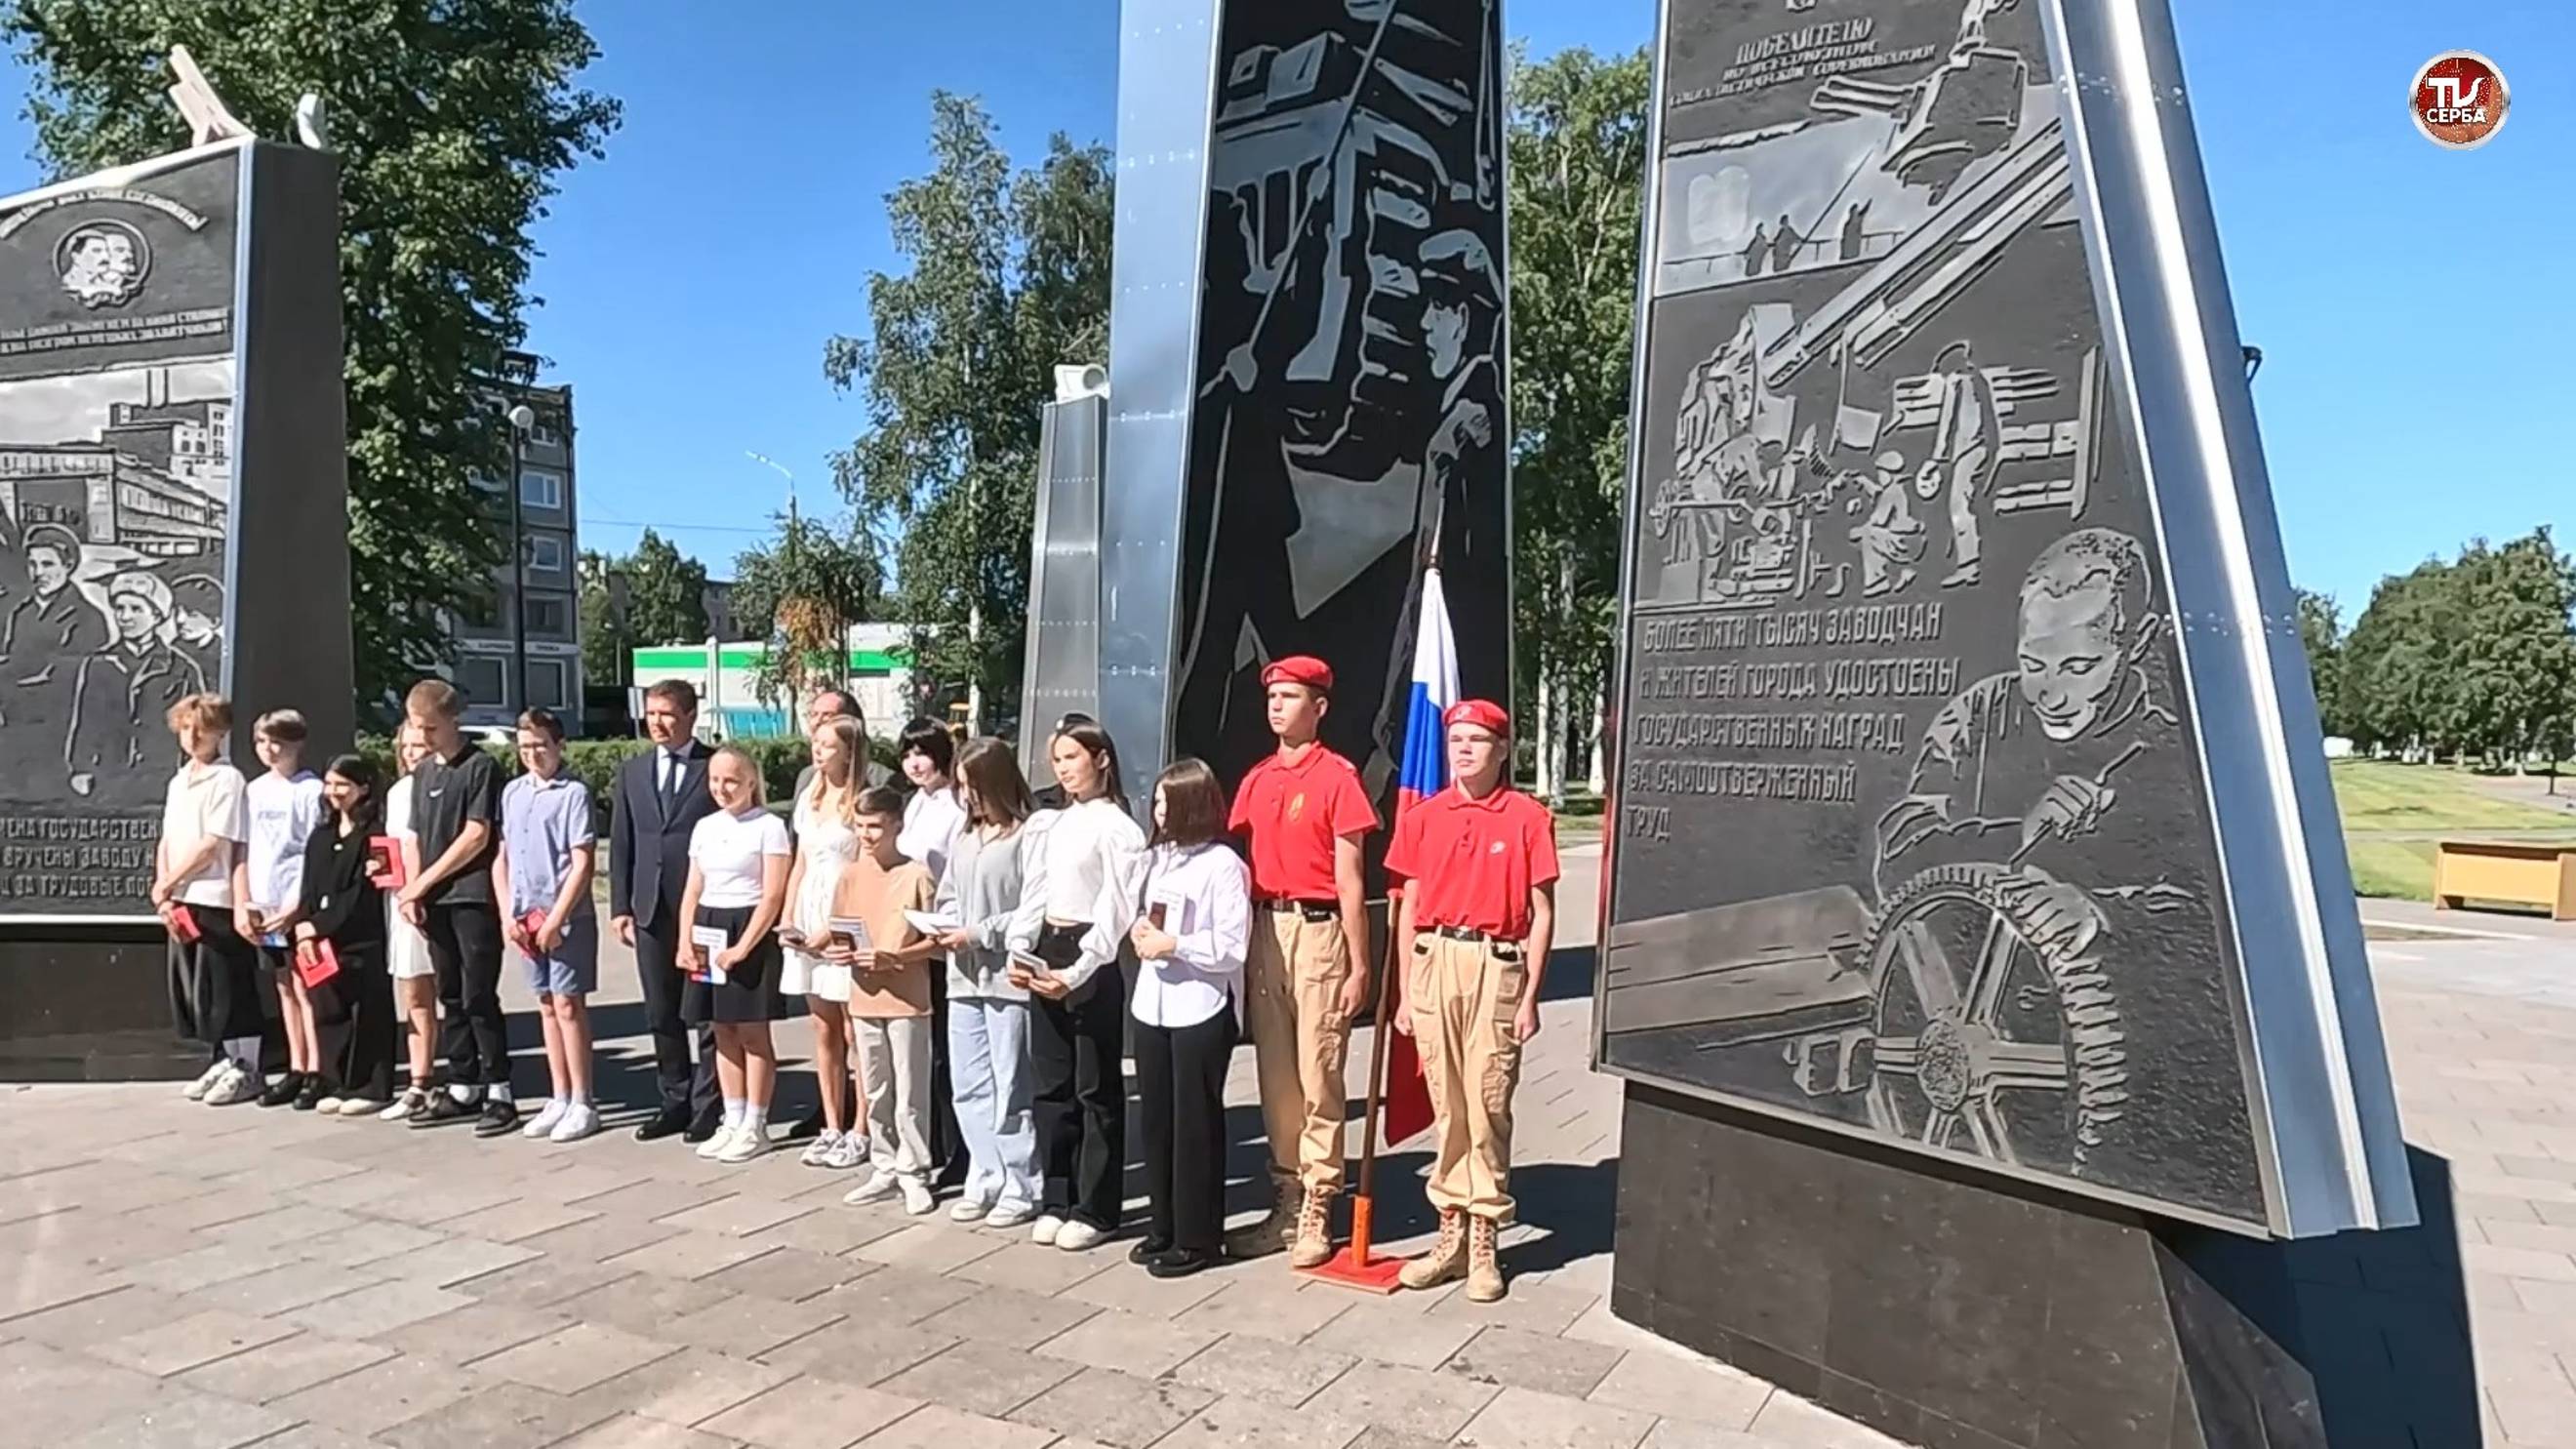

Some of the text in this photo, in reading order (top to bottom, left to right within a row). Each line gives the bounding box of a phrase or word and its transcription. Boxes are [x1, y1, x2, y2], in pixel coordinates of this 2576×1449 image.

[1643, 602, 1944, 652] БОЛЕЕ ПЯТИ ТЫСЯЧ ЗАВОДЧАН
[1639, 657, 1961, 701] И ЖИТЕЛЕЙ ГОРОДА УДОСТОЕНЫ
[1634, 712, 1907, 755] ГОСУДАРСТВЕННЫХ НАГРАД
[1630, 759, 1857, 803] ЗА САМООТВЕРЖЕННЫЙ
[1627, 805, 1671, 843] ТРУД
[3, 845, 75, 870] ВРУЧЕНЫ
[80, 845, 142, 870] ЗАВОДУ
[15, 874, 36, 896] ЗА
[40, 874, 124, 897] ТРУДОВЫЕ
